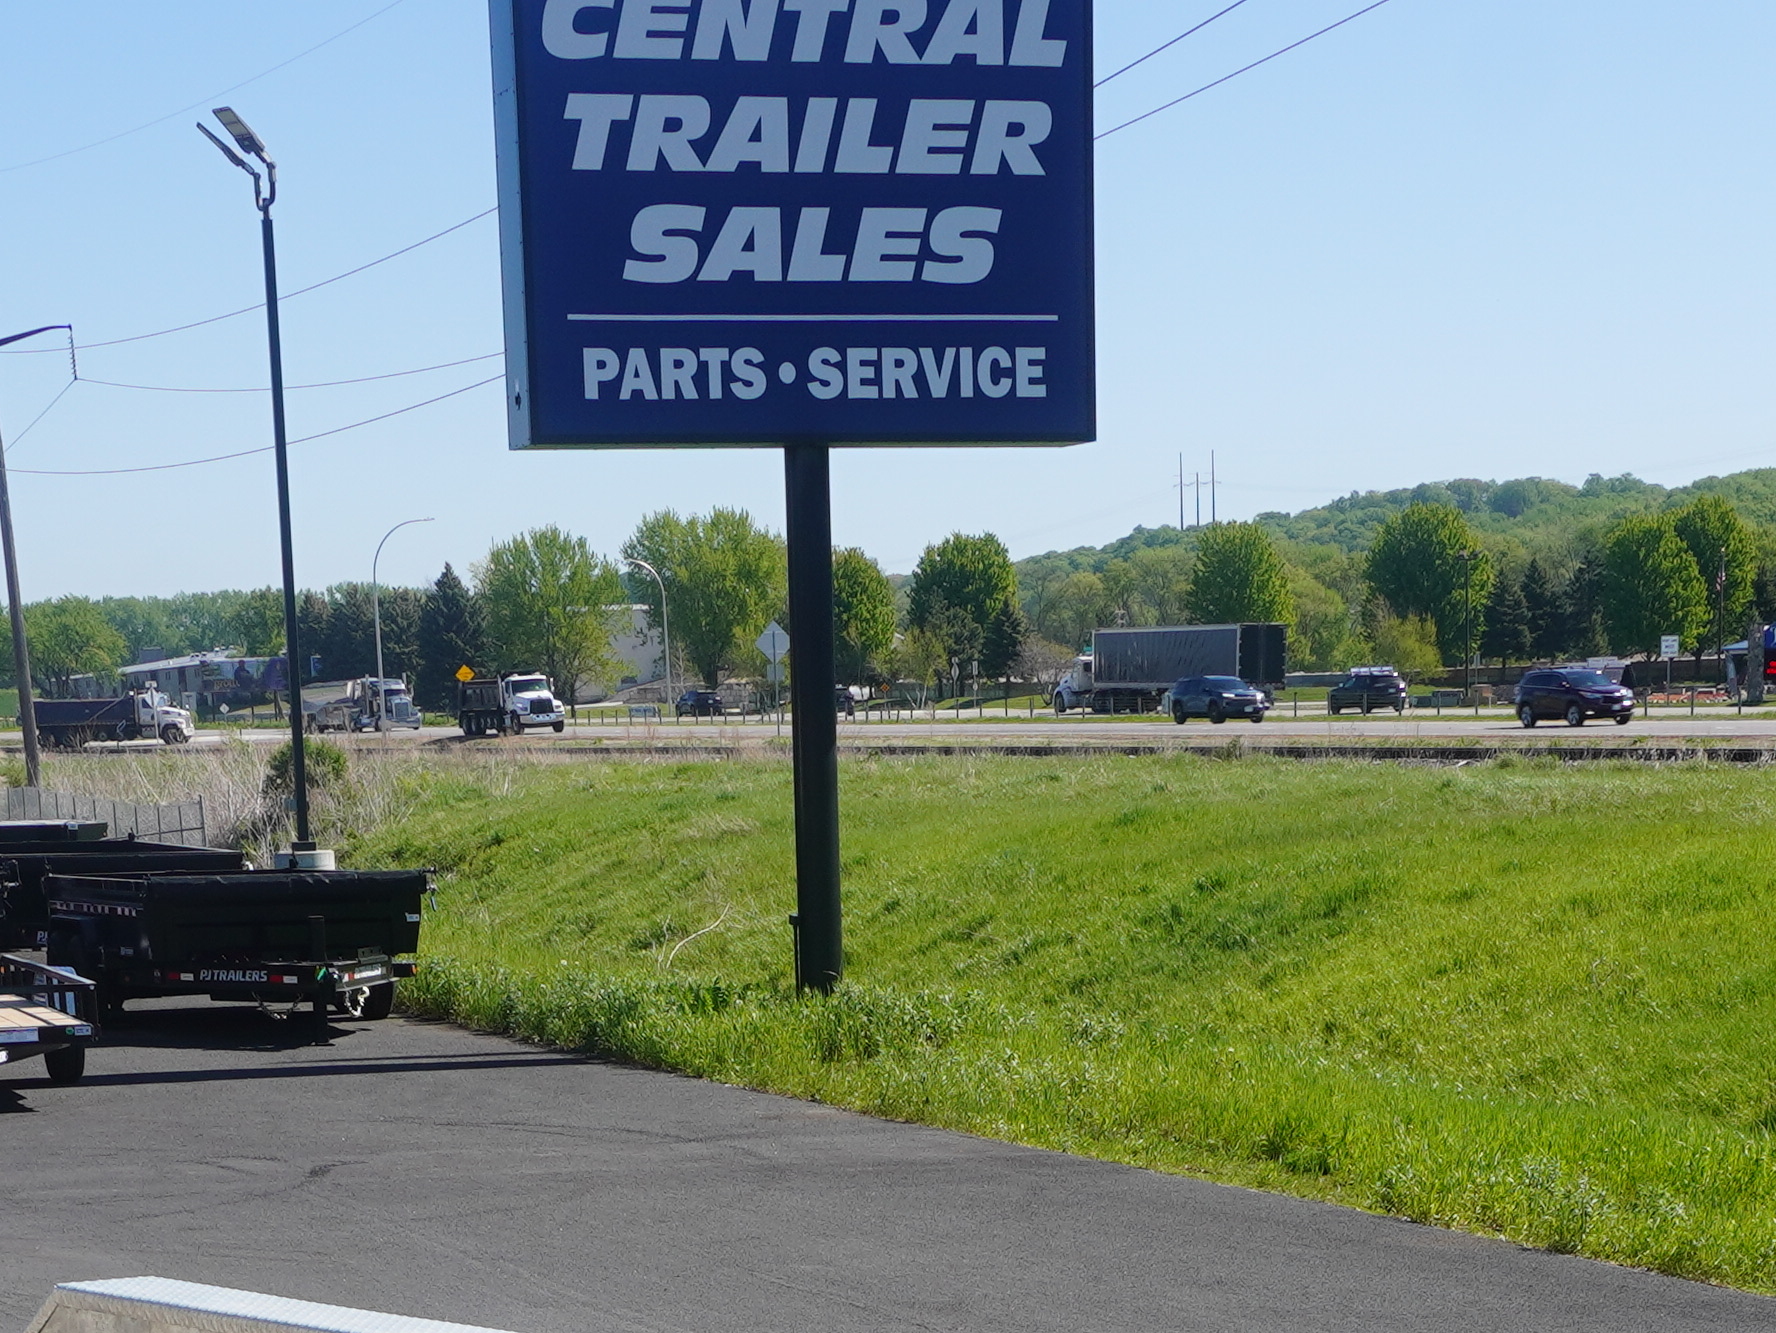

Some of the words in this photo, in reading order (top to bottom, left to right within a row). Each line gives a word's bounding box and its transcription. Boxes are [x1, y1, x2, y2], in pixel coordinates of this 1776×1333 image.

[541, 0, 1067, 67] CENTRAL
[563, 93, 1052, 176] TRAILER
[622, 204, 1002, 284] SALES
[582, 347, 767, 400] PARTS
[806, 346, 1047, 398] SERVICE
